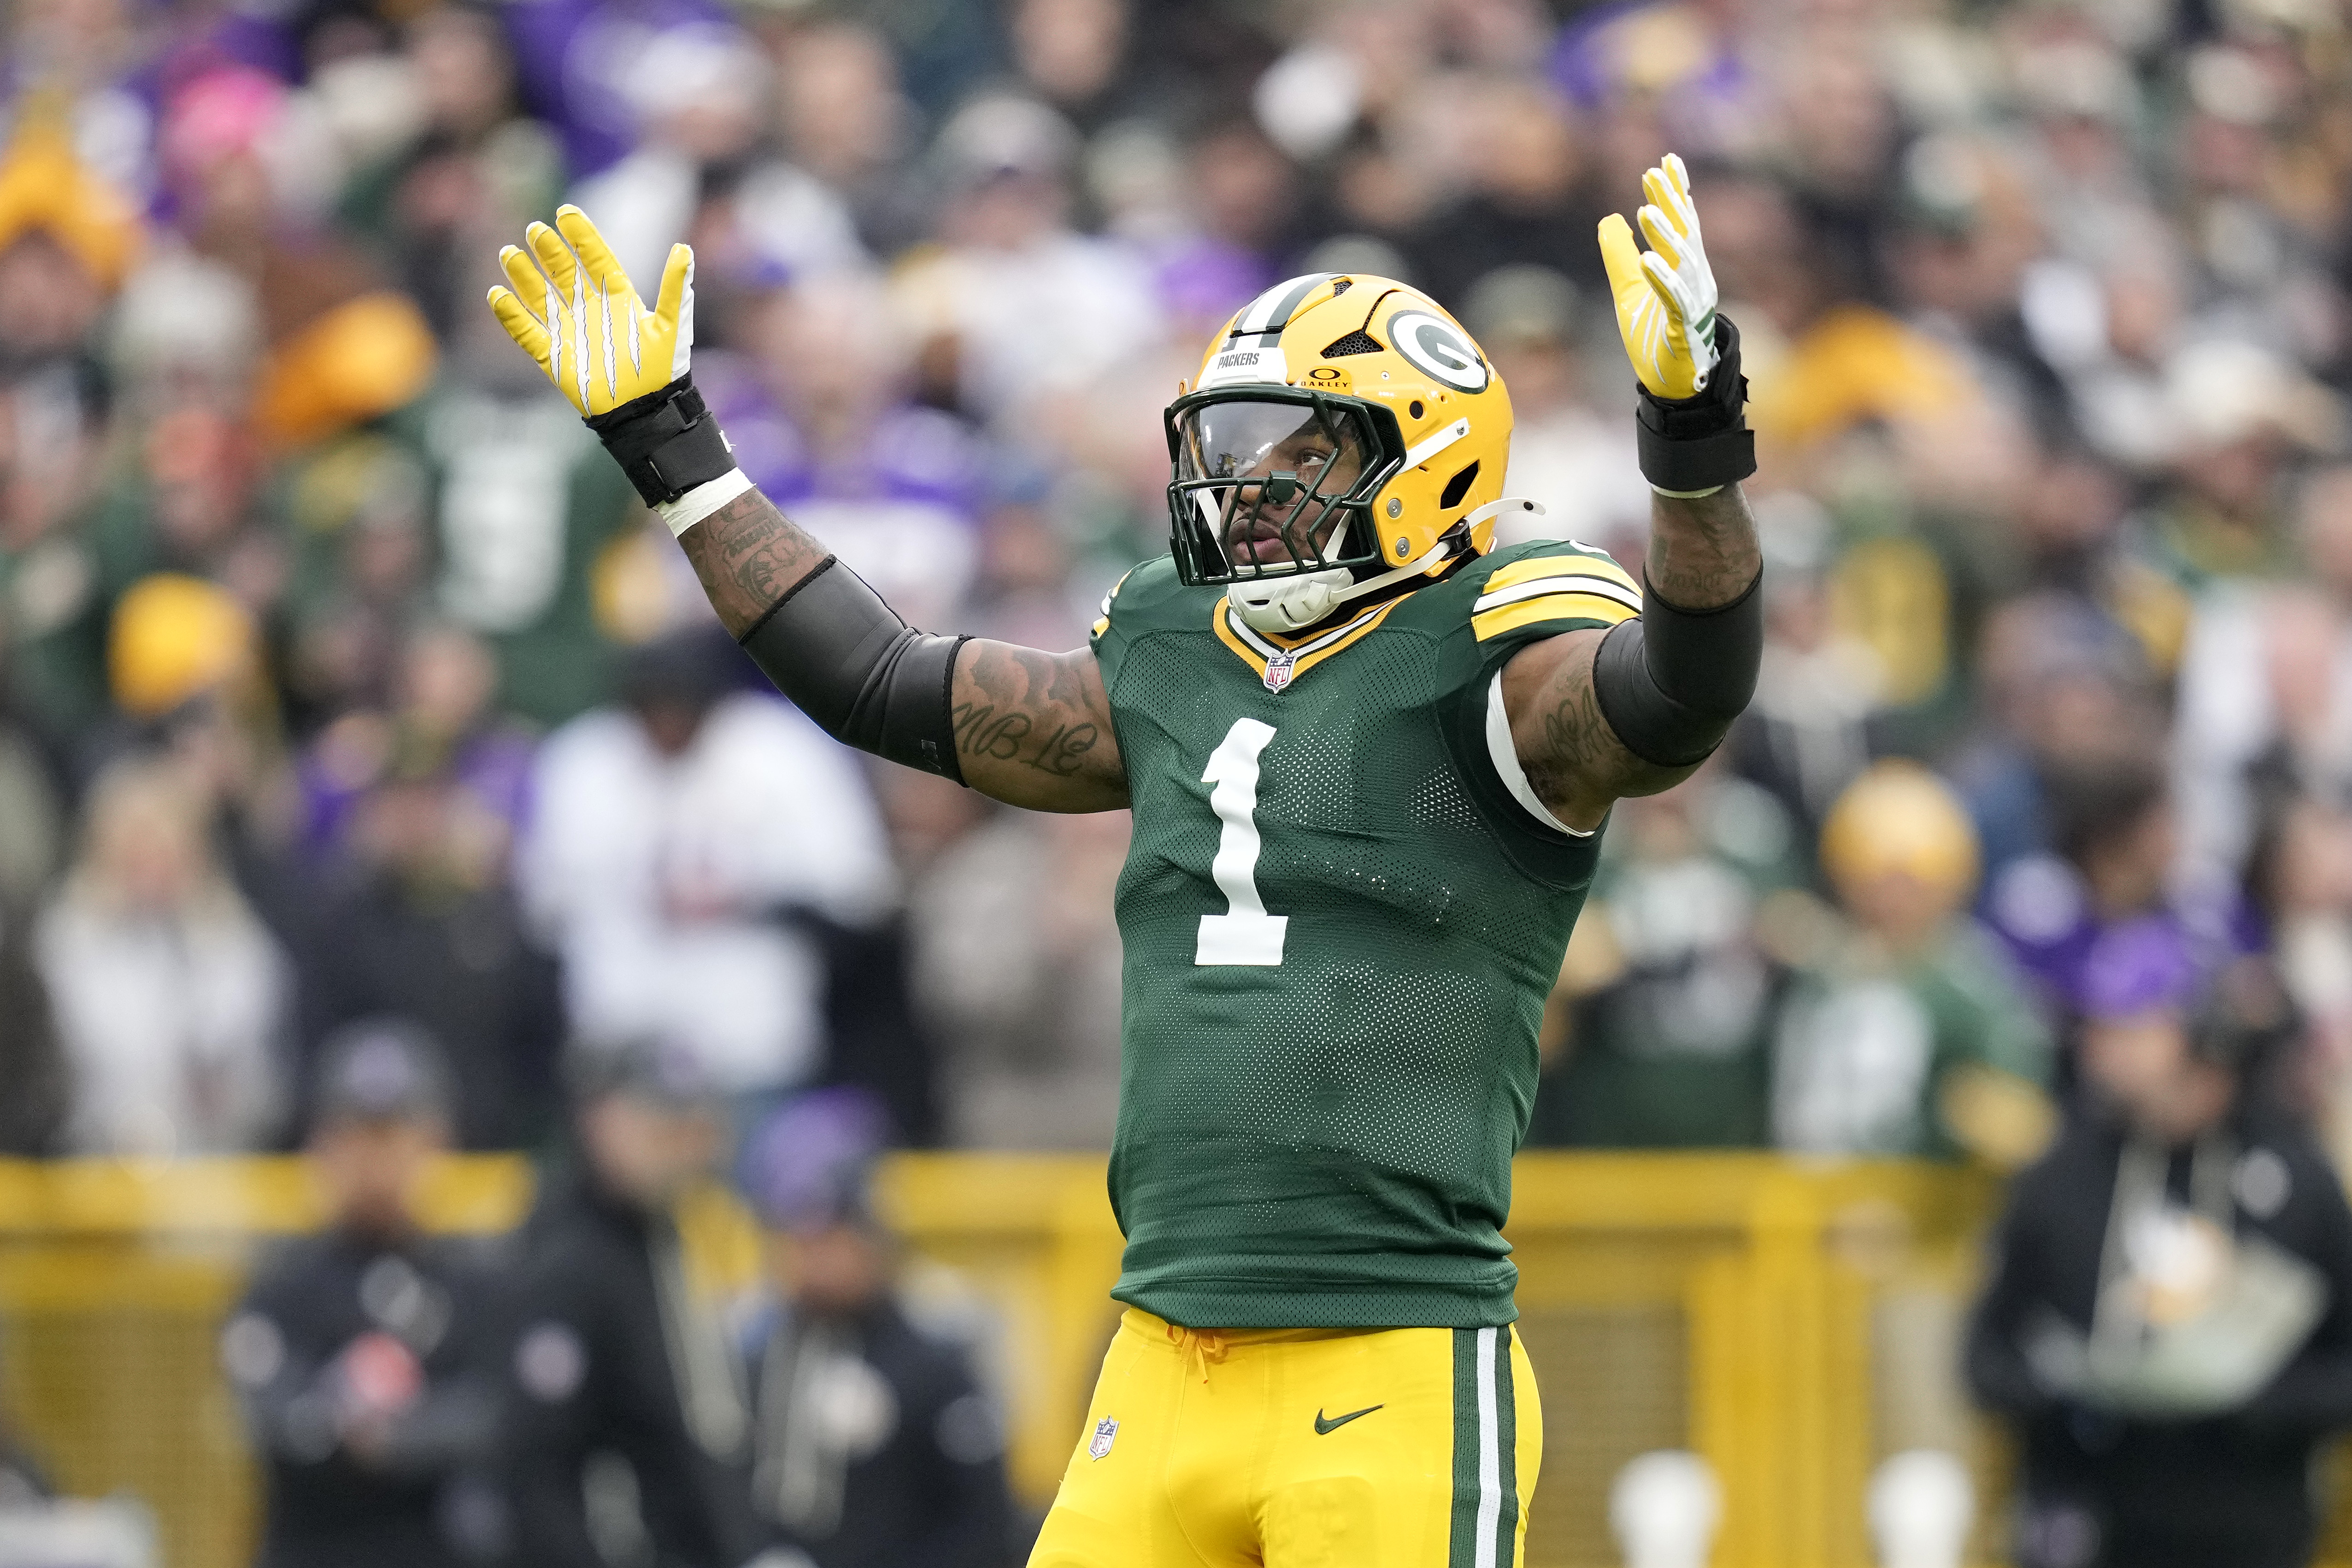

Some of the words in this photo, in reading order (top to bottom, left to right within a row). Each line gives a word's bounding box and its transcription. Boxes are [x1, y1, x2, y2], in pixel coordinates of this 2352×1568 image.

[1217, 352, 1260, 370] PACKERS
[1268, 668, 1286, 685] NFL
[1194, 717, 1289, 966] 1
[1092, 1435, 1108, 1452] NFL
